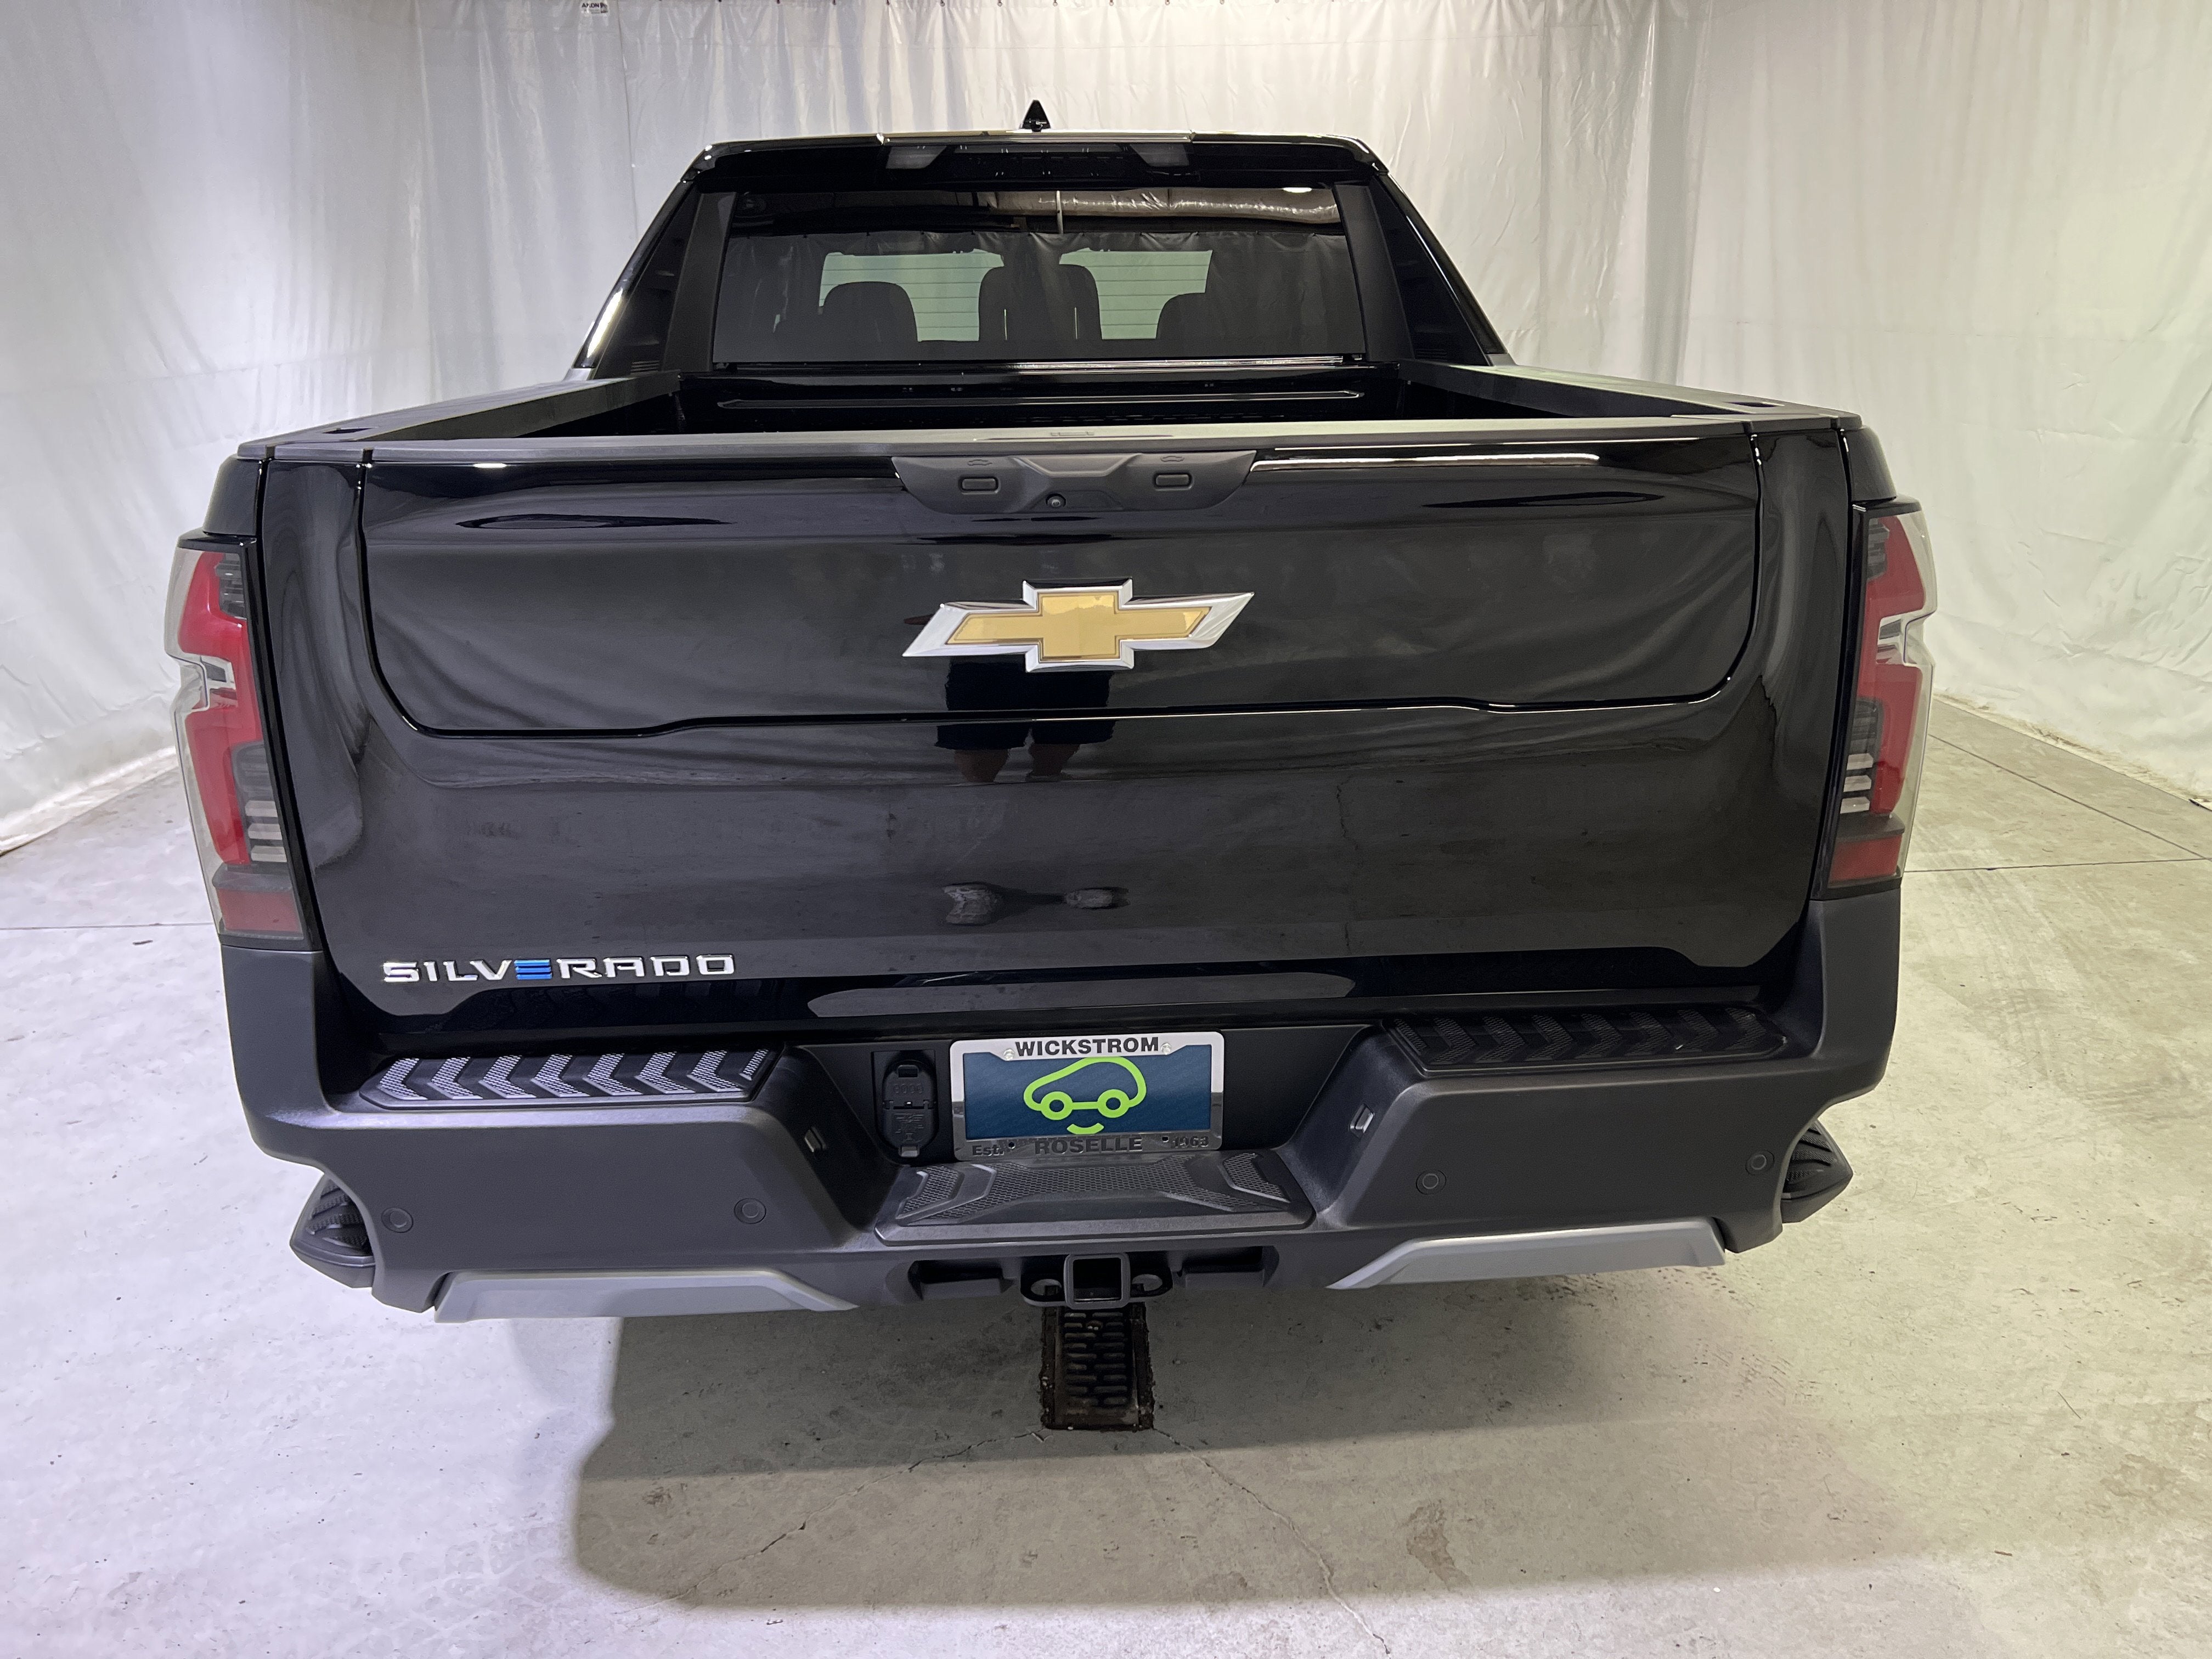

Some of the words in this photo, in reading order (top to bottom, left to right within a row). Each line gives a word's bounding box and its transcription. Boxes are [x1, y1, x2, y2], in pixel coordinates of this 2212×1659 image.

[383, 954, 734, 982] SILVERADO
[1015, 1036, 1159, 1057] WICKSTROM
[1035, 1136, 1143, 1155] ROSELLE
